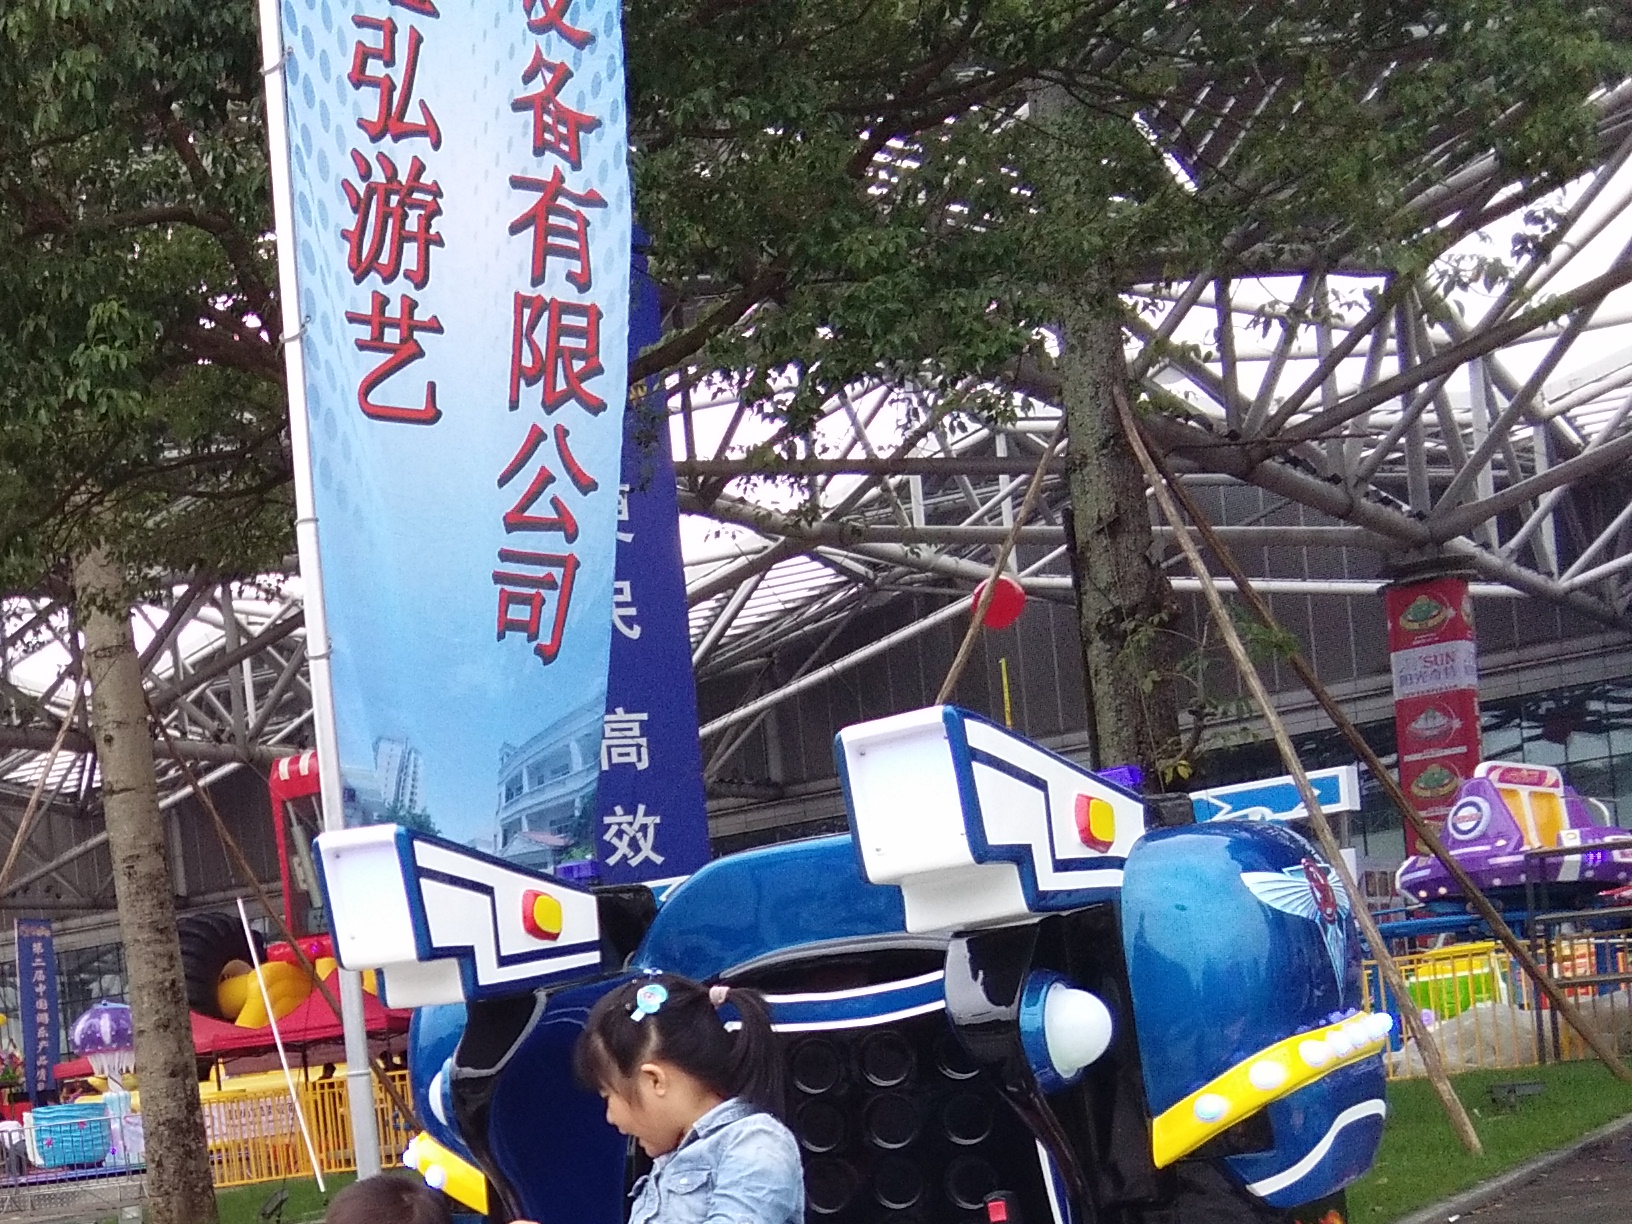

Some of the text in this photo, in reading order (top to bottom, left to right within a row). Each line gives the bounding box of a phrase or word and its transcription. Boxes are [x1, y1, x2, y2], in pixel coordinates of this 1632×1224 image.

[340, 0, 445, 425] 弘游艺
[600, 707, 665, 868] 高效
